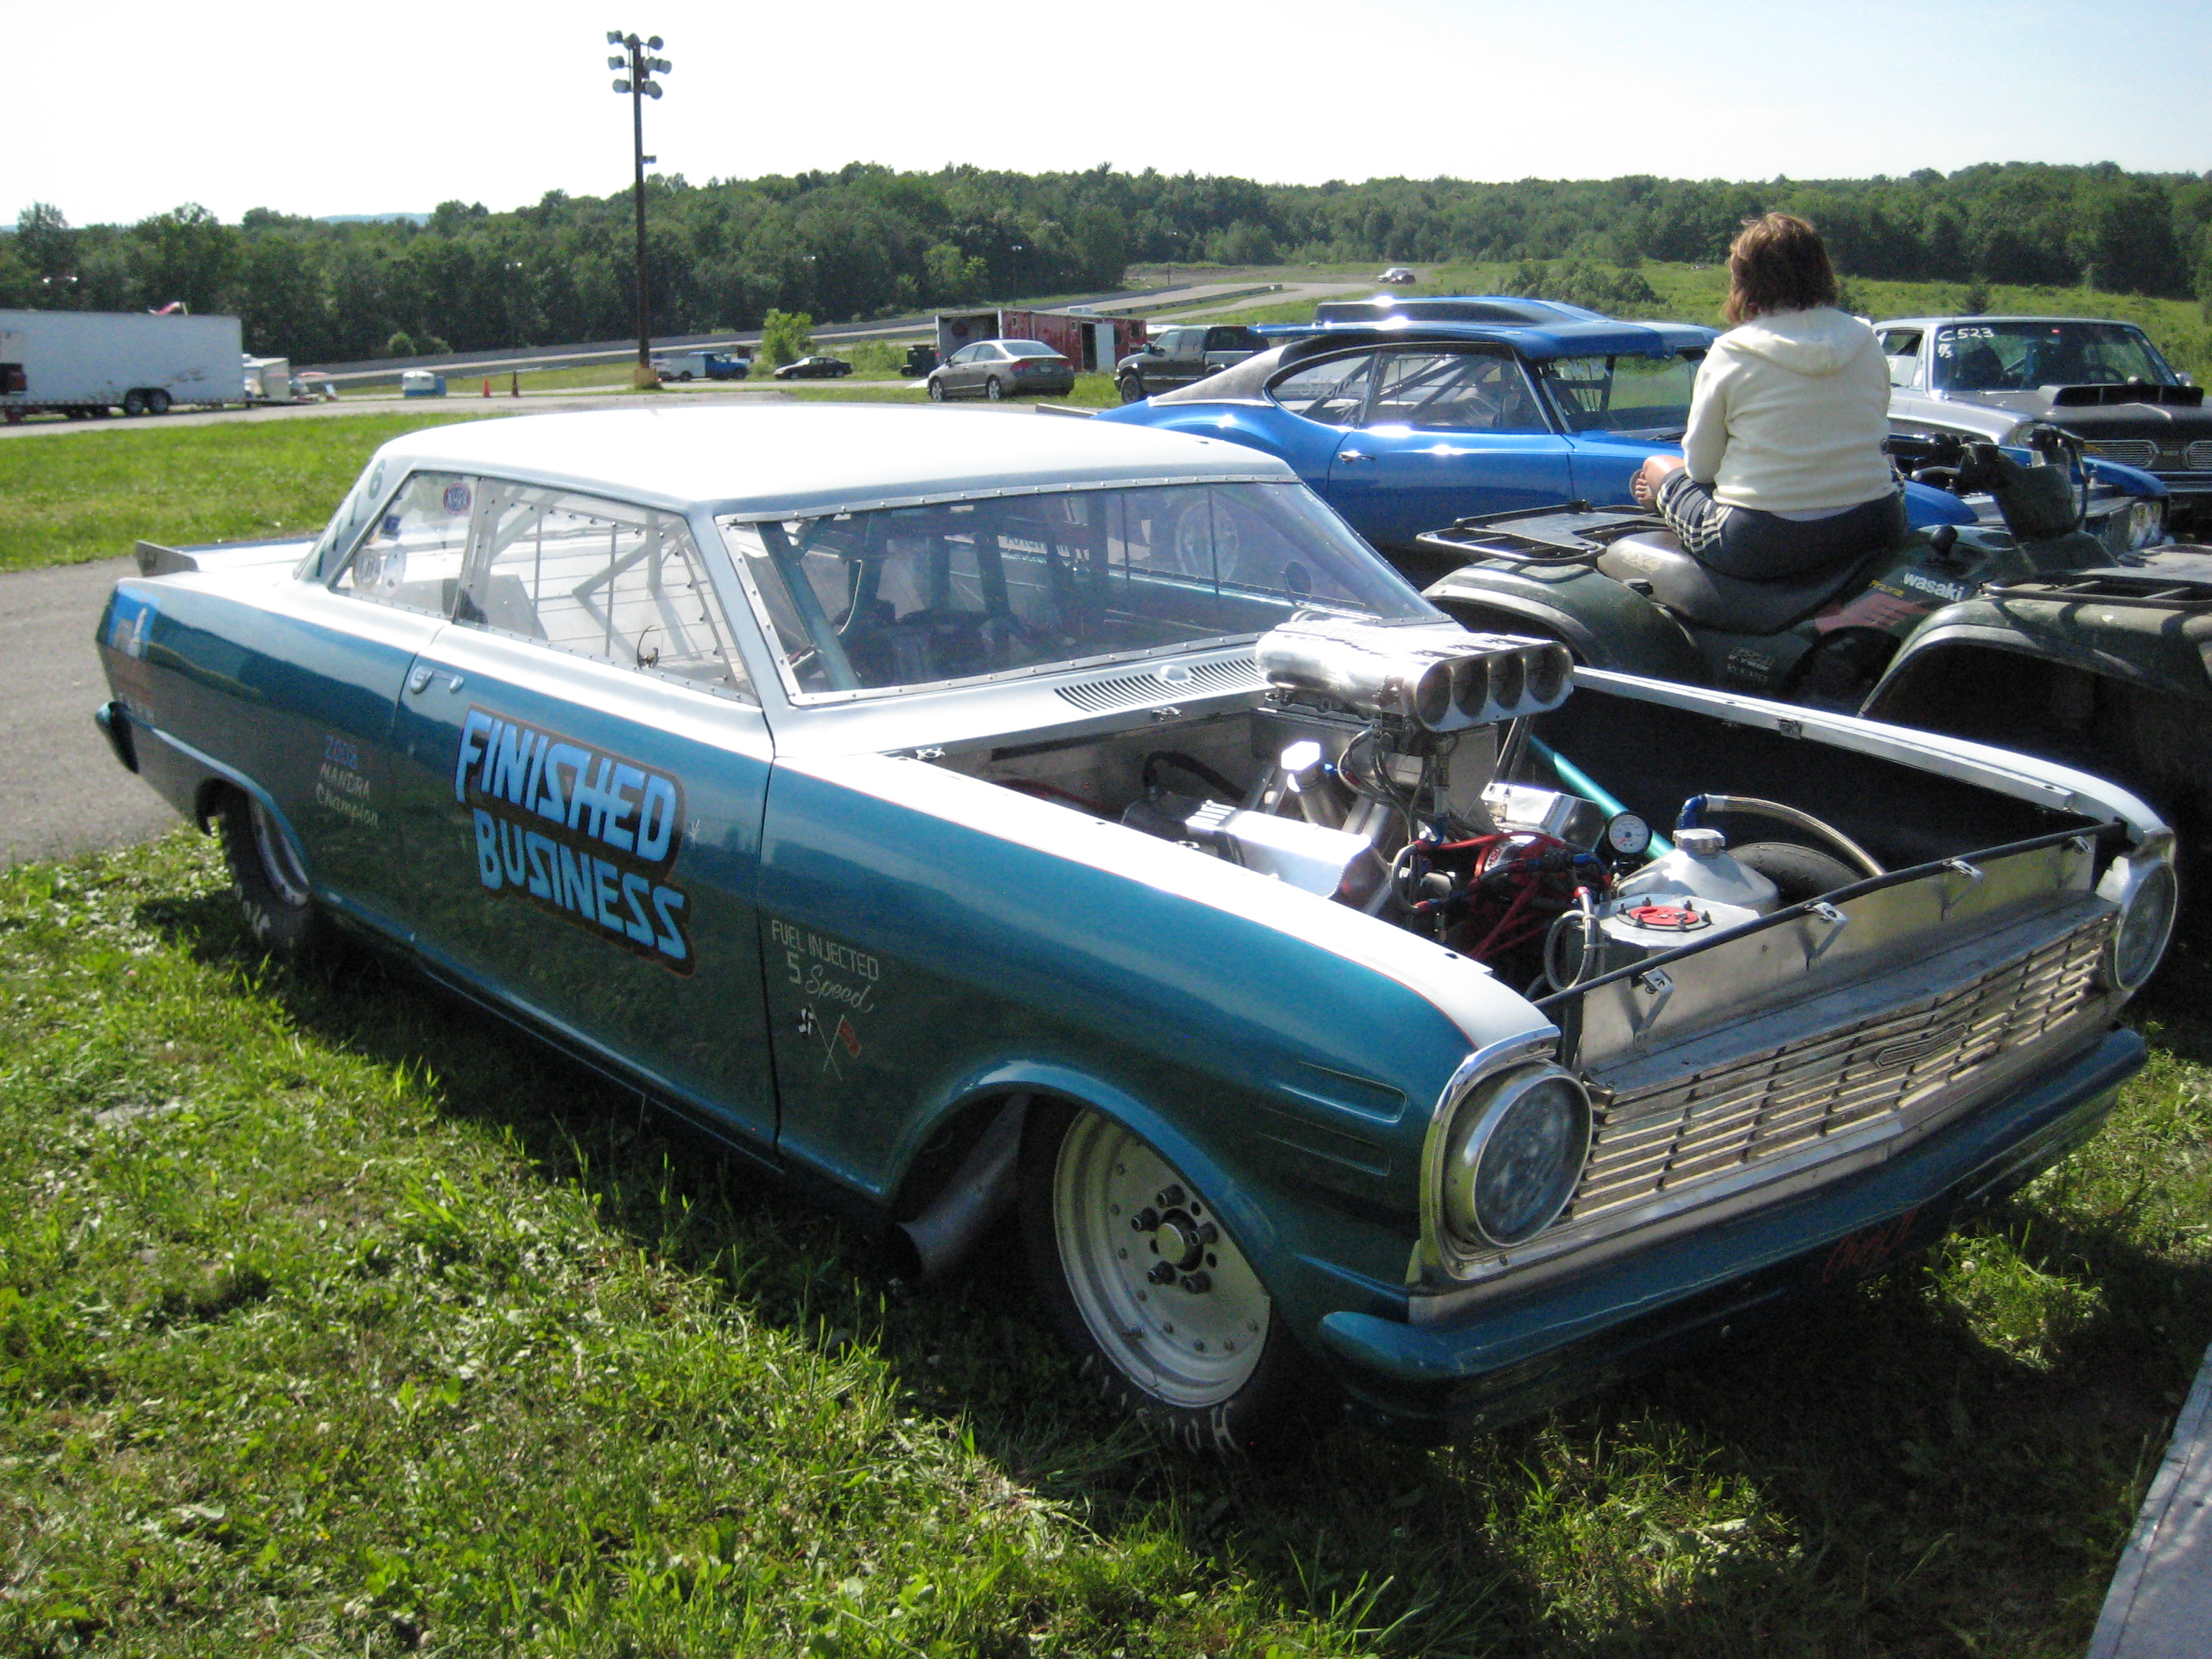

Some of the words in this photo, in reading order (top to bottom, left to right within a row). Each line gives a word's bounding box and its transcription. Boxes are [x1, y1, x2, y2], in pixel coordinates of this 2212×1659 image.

[454, 709, 678, 863] FINISHED
[472, 807, 687, 960] BUSINESS
[771, 919, 806, 953] FUEL
[807, 933, 880, 981] INJECTED
[786, 950, 801, 985] 5
[805, 963, 875, 1014] Speed
